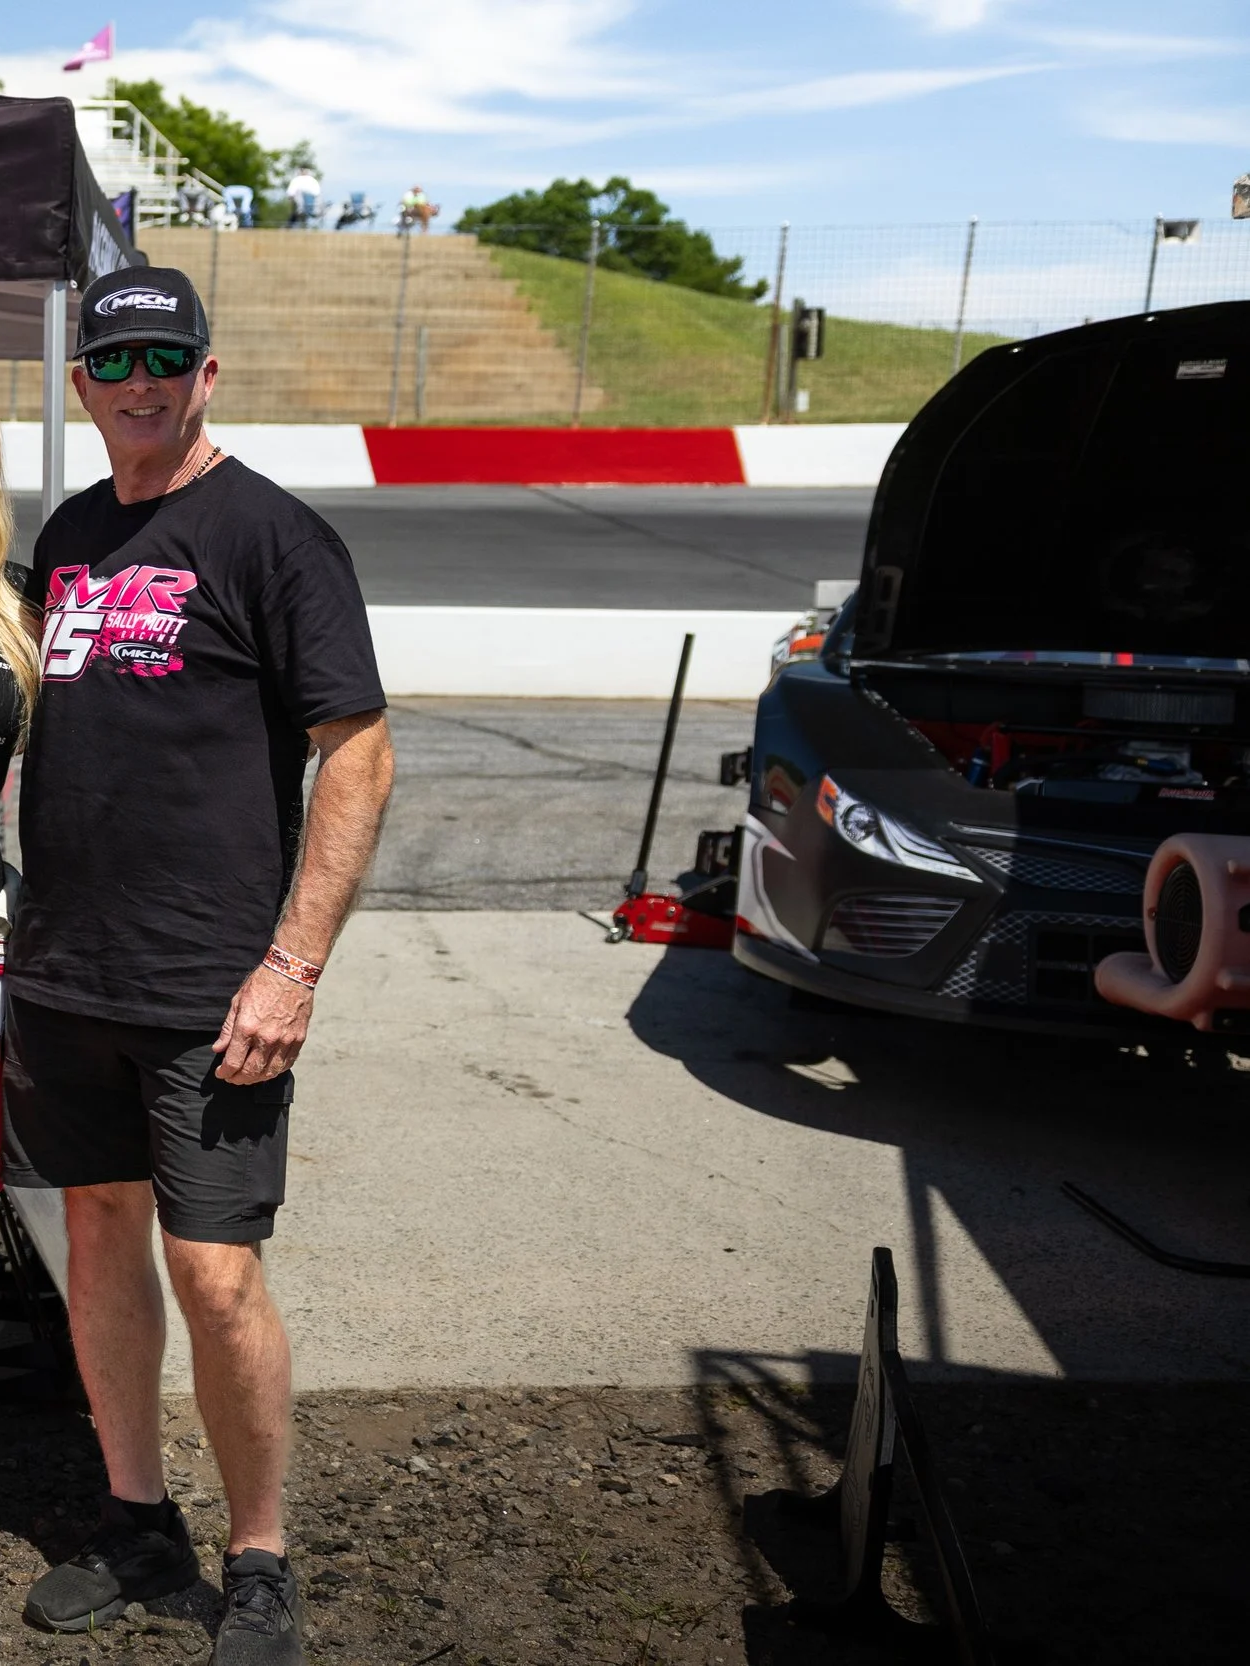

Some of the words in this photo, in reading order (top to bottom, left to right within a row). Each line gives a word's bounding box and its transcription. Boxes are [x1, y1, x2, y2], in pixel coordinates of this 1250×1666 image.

[111, 293, 178, 310] MKM
[45, 564, 198, 613] SMR
[106, 612, 141, 631] SALLY
[141, 614, 188, 635] MOTT
[41, 612, 107, 681] 15
[121, 649, 170, 661] MKM
